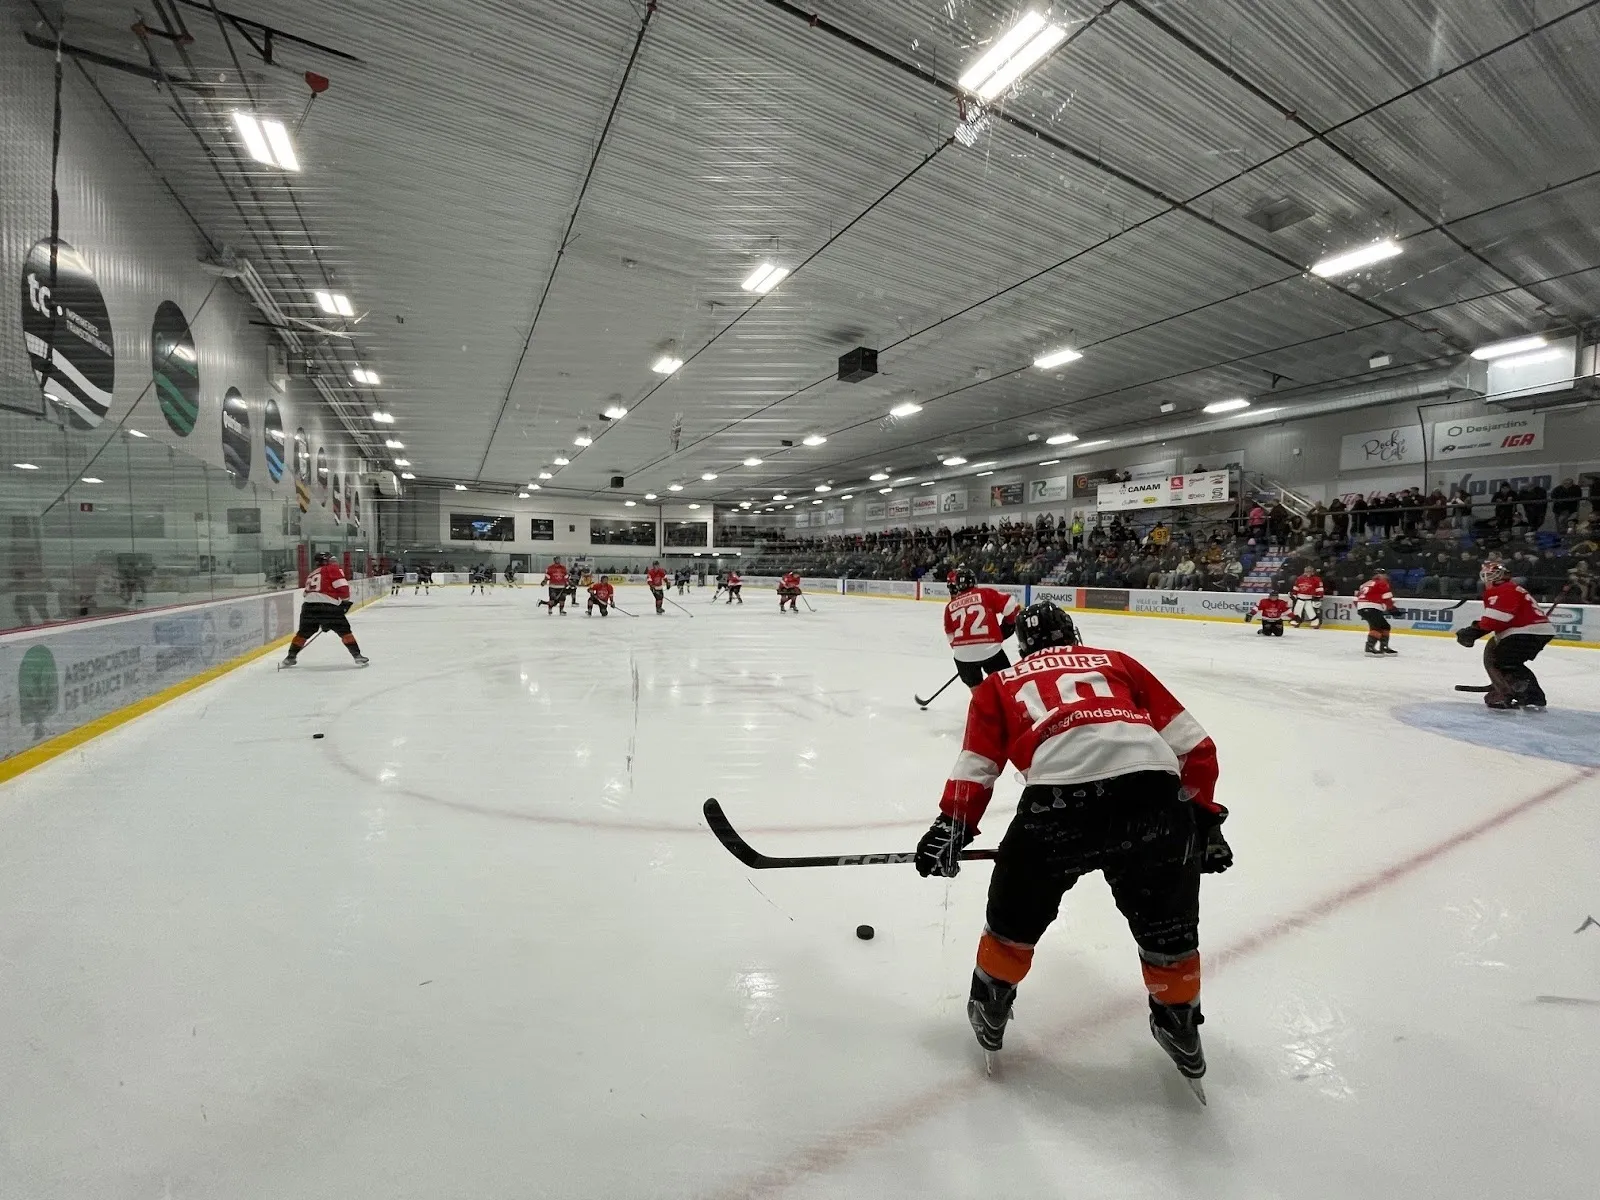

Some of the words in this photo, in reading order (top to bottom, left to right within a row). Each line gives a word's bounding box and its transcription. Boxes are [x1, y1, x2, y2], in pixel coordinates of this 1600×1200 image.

[1466, 420, 1527, 433] Desjardins
[1362, 429, 1399, 460] Rock
[1500, 433, 1535, 448] IGA
[1127, 483, 1161, 493] CANAM
[1034, 592, 1073, 602] ABENAKIS
[1135, 604, 1186, 615] BEAUCEVILLE
[1201, 599, 1240, 611] Québec
[951, 604, 989, 638] 72
[1025, 615, 1039, 628] 19
[1001, 654, 1108, 680] LECOURS
[837, 853, 916, 866] CCM
